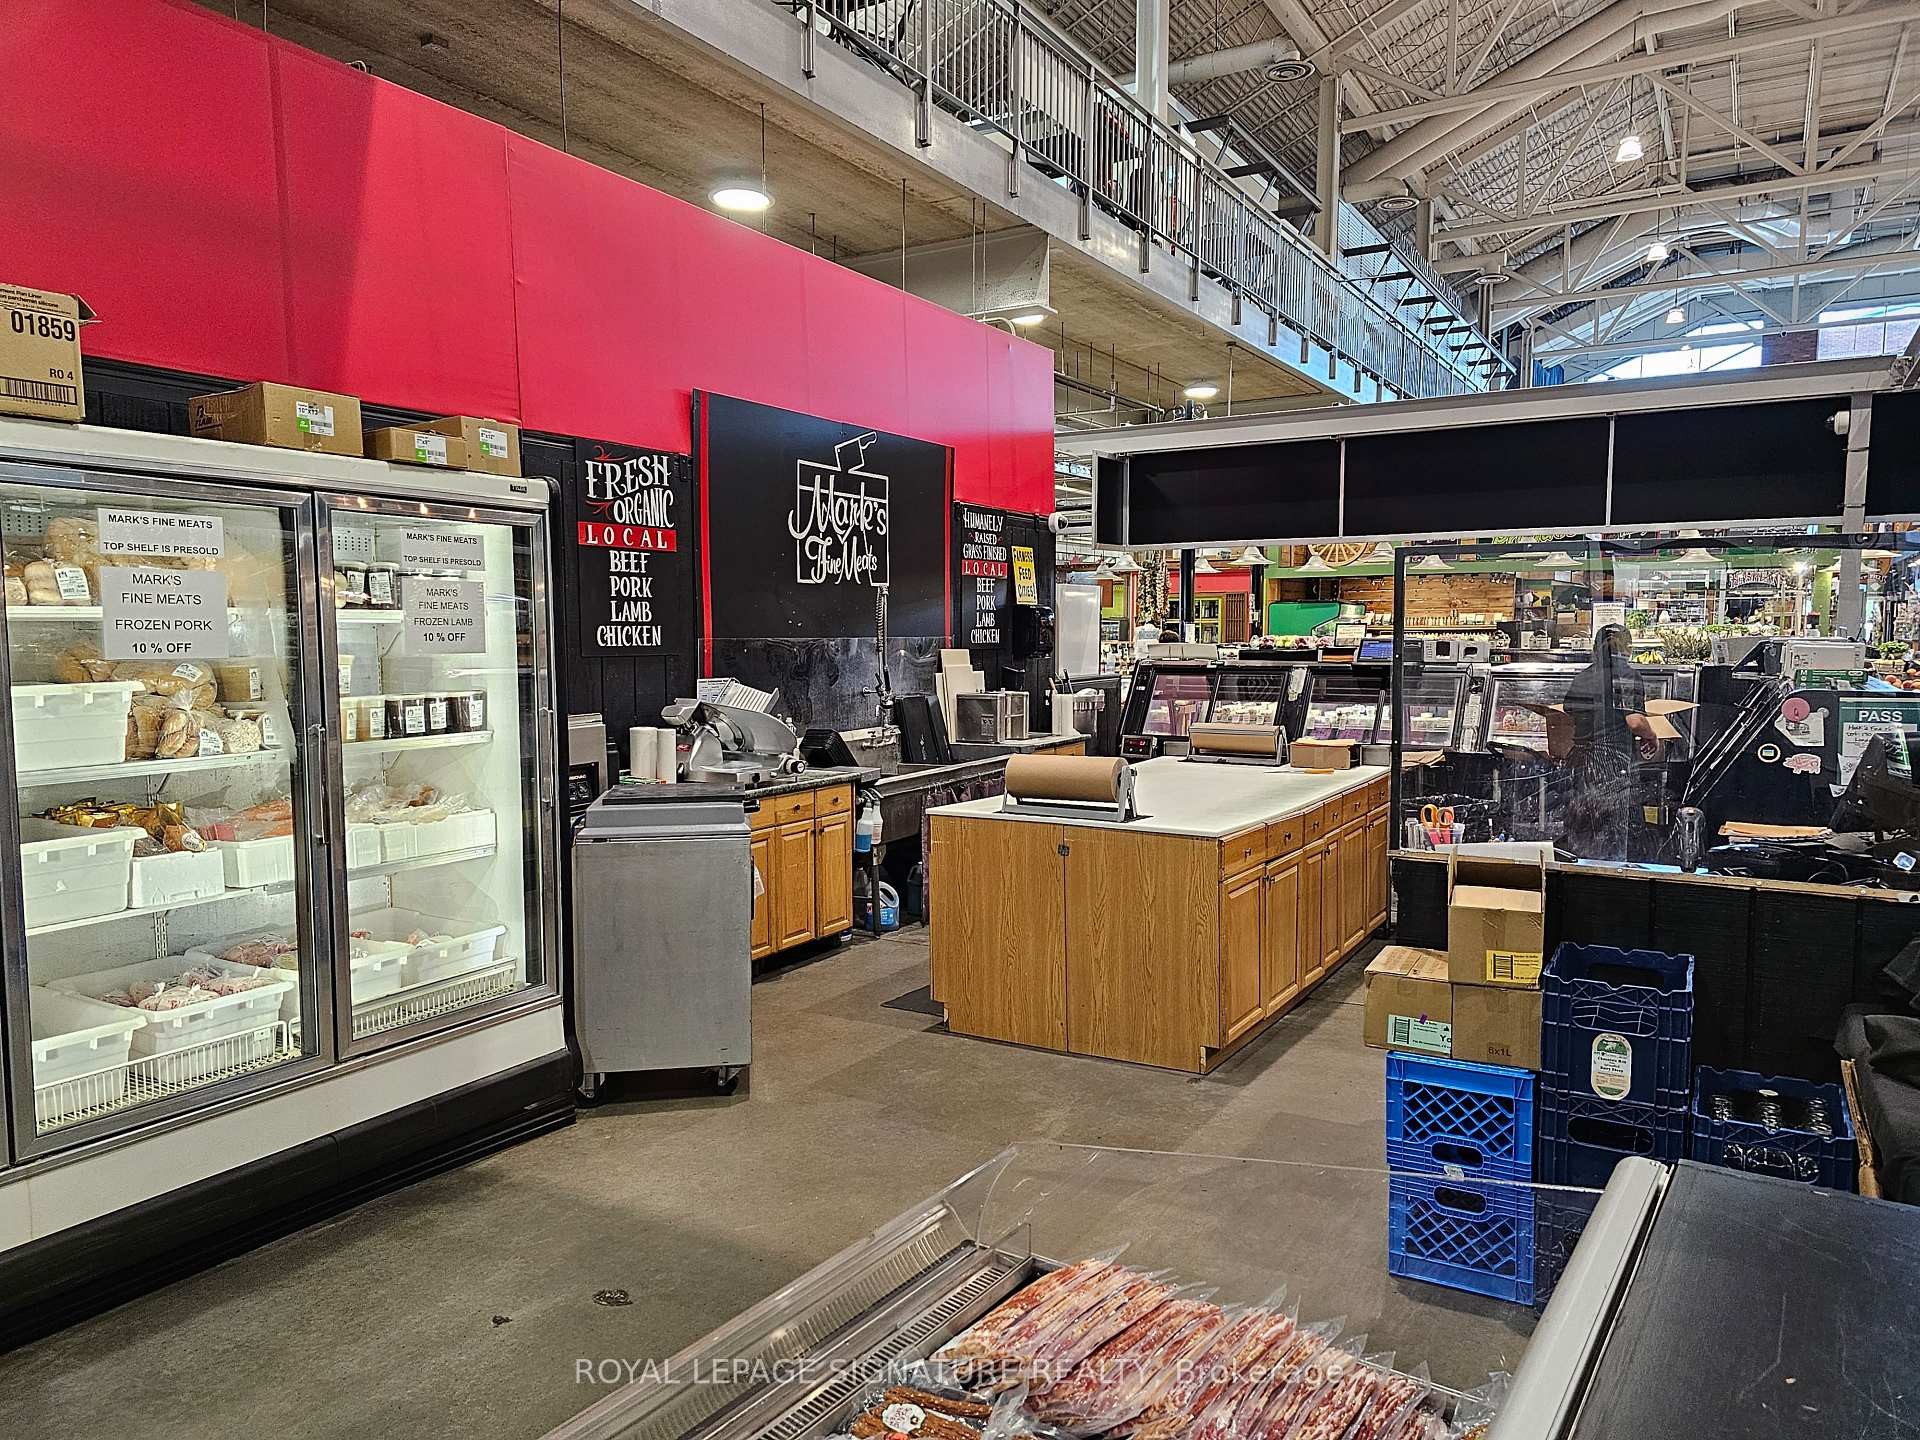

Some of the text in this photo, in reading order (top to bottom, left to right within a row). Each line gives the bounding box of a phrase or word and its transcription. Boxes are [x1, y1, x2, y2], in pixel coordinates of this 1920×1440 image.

[11, 310, 76, 342] 01859
[67, 371, 74, 381] 4
[585, 454, 672, 500] FRESH
[613, 487, 675, 529] ORGANIC
[788, 474, 887, 540] Mark's
[108, 514, 213, 529] MARK'S FINE MEATS
[962, 507, 1004, 532] HUMANELY
[406, 532, 477, 545] MARK'S FINE MEATS
[586, 524, 668, 549] LOCAL
[973, 531, 998, 545] RAISED
[104, 541, 219, 556] TOP SHELF IS PRESOLD
[962, 543, 1007, 562] GRASS FINISHED
[419, 556, 441, 564] SHELF
[442, 557, 449, 565] IS
[450, 558, 481, 567] PRESOLD
[609, 550, 651, 574] BEEF
[805, 535, 878, 585] Fine Meats
[964, 561, 1003, 577] LOCAL
[132, 573, 182, 586] MARK'S
[609, 575, 653, 598] PORK
[976, 577, 996, 594] BEEF
[121, 593, 202, 605] FINE MEATS
[426, 587, 458, 597] MARK'S
[419, 601, 469, 611] FINE MEATS
[976, 594, 997, 611] PORK
[610, 600, 652, 623] LAMB
[115, 619, 213, 631] FROZEN PORK
[414, 617, 473, 626] FROZEN LAMB
[975, 612, 996, 628] LAMB
[423, 632, 466, 642] 10 % OFF
[596, 625, 662, 648] CHICKEN
[970, 628, 1000, 644] CHICKEN
[132, 642, 192, 654] 10 % OFF
[1858, 710, 1903, 722] PASS
